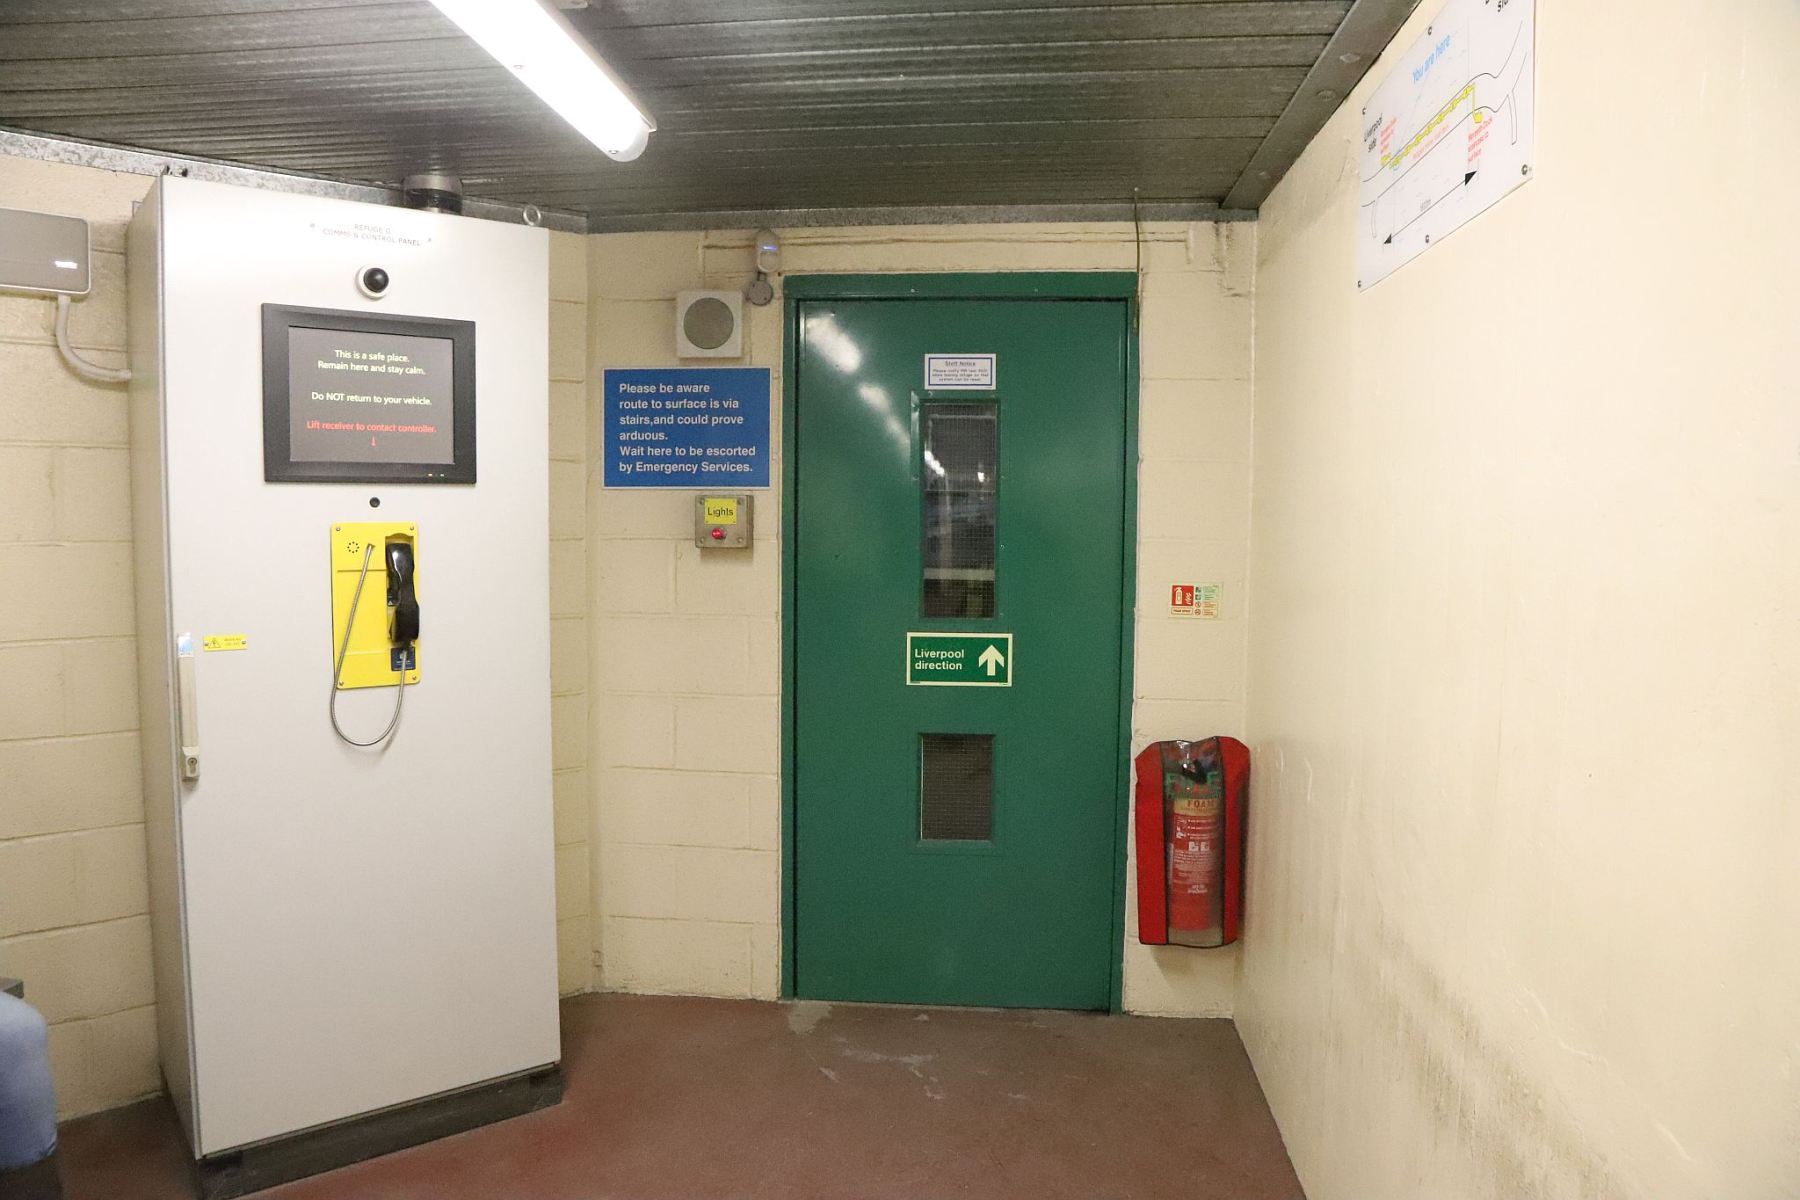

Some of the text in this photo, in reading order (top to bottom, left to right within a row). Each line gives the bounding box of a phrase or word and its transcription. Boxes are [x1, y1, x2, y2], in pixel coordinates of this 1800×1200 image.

[1412, 34, 1451, 85] You are here
[361, 233, 396, 244] CONTROL
[398, 237, 421, 246] PANEL
[335, 349, 352, 359] This
[353, 350, 360, 359] is
[368, 352, 385, 361] safe
[387, 353, 410, 363] place.
[317, 360, 426, 375] Remain here and stay calm.
[619, 383, 710, 393] Please be aware
[311, 391, 433, 406] Do NOT return to your vehicle.
[619, 399, 739, 409] route to surface is via
[677, 414, 708, 425] could
[712, 416, 744, 426] prove
[307, 421, 437, 433] Lift receiver to contact controller.
[619, 430, 668, 441] arduous.
[620, 446, 756, 456] Wait here to be escorted
[619, 462, 753, 474] by Emergency Services.
[707, 507, 734, 517] Lights
[914, 649, 965, 660] Liverpool
[915, 661, 963, 670] direction
